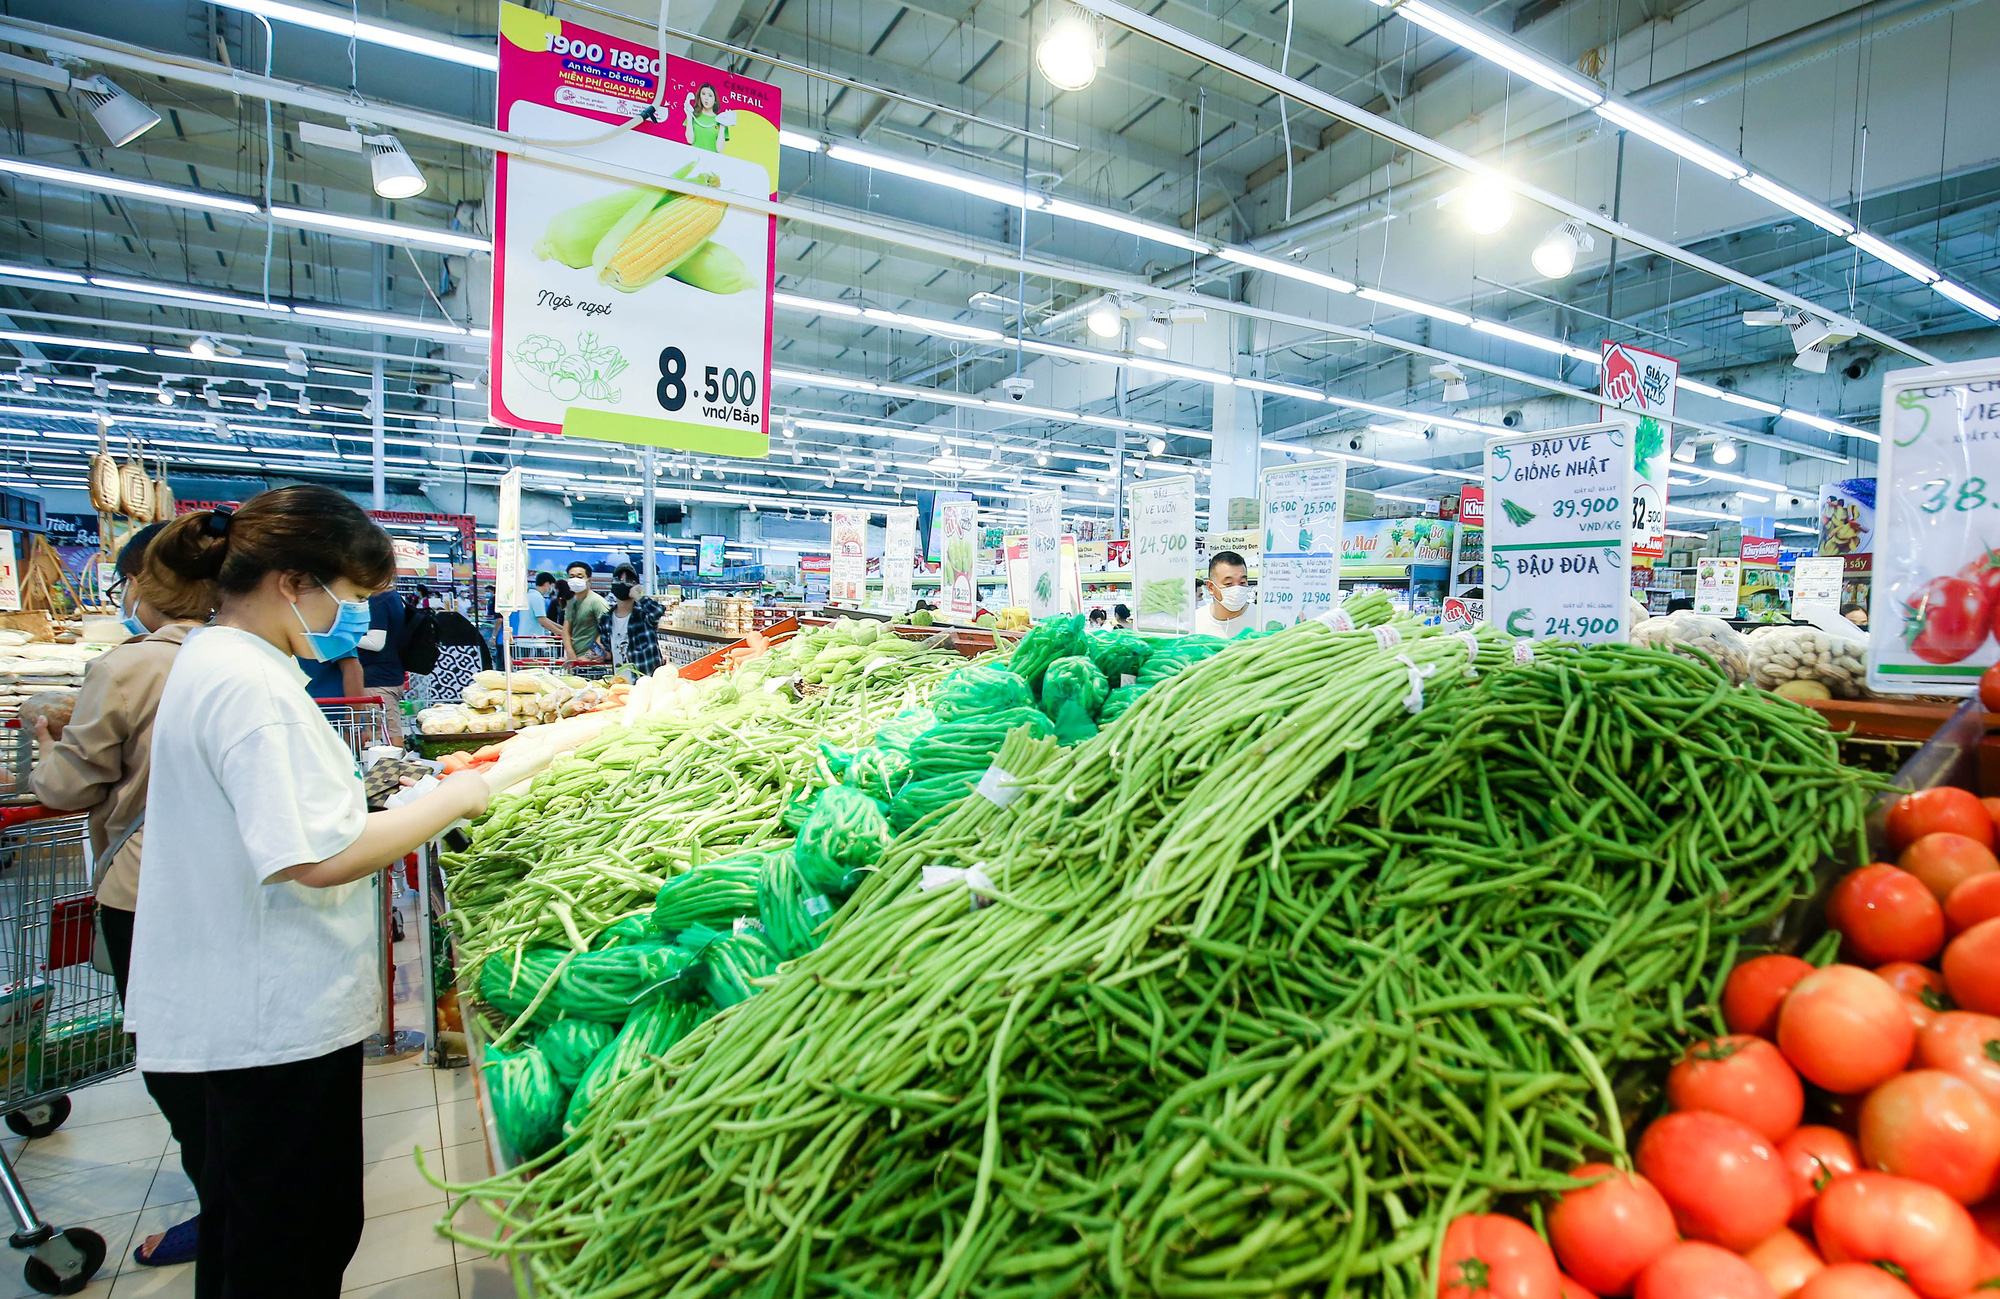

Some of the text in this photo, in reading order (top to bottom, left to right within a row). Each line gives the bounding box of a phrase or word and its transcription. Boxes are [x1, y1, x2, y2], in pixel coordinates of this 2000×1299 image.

[545, 32, 604, 63] 1900
[567, 61, 581, 70] An
[582, 63, 601, 76] tâm
[622, 76, 646, 87] dàng
[558, 70, 655, 99] MIỄN PHÍ GIAO HÀNG
[723, 81, 770, 101] CENTRAL
[730, 91, 763, 109] RETAIL
[537, 289, 612, 316] Ngô ngọt
[1646, 366, 1661, 381] GIÁ
[702, 405, 760, 425] vnd/Bắp
[1568, 436, 1591, 452] VE
[1566, 456, 1610, 477] NHẬT
[1269, 500, 1297, 514] 16.500
[1304, 501, 1336, 516] 25.500
[1553, 497, 1619, 518] 39.900
[1431, 525, 1445, 539] Bơ
[1579, 520, 1621, 532] VND/KG
[1140, 534, 1187, 555] 24.900
[1353, 534, 1378, 551] Mai
[1419, 546, 1437, 560] Pho
[1517, 554, 1554, 578] ĐẬU
[1850, 557, 1867, 570] sấy
[1264, 591, 1293, 604] 22.900
[1302, 591, 1330, 604] 22.900
[1545, 616, 1619, 637] 24.900
